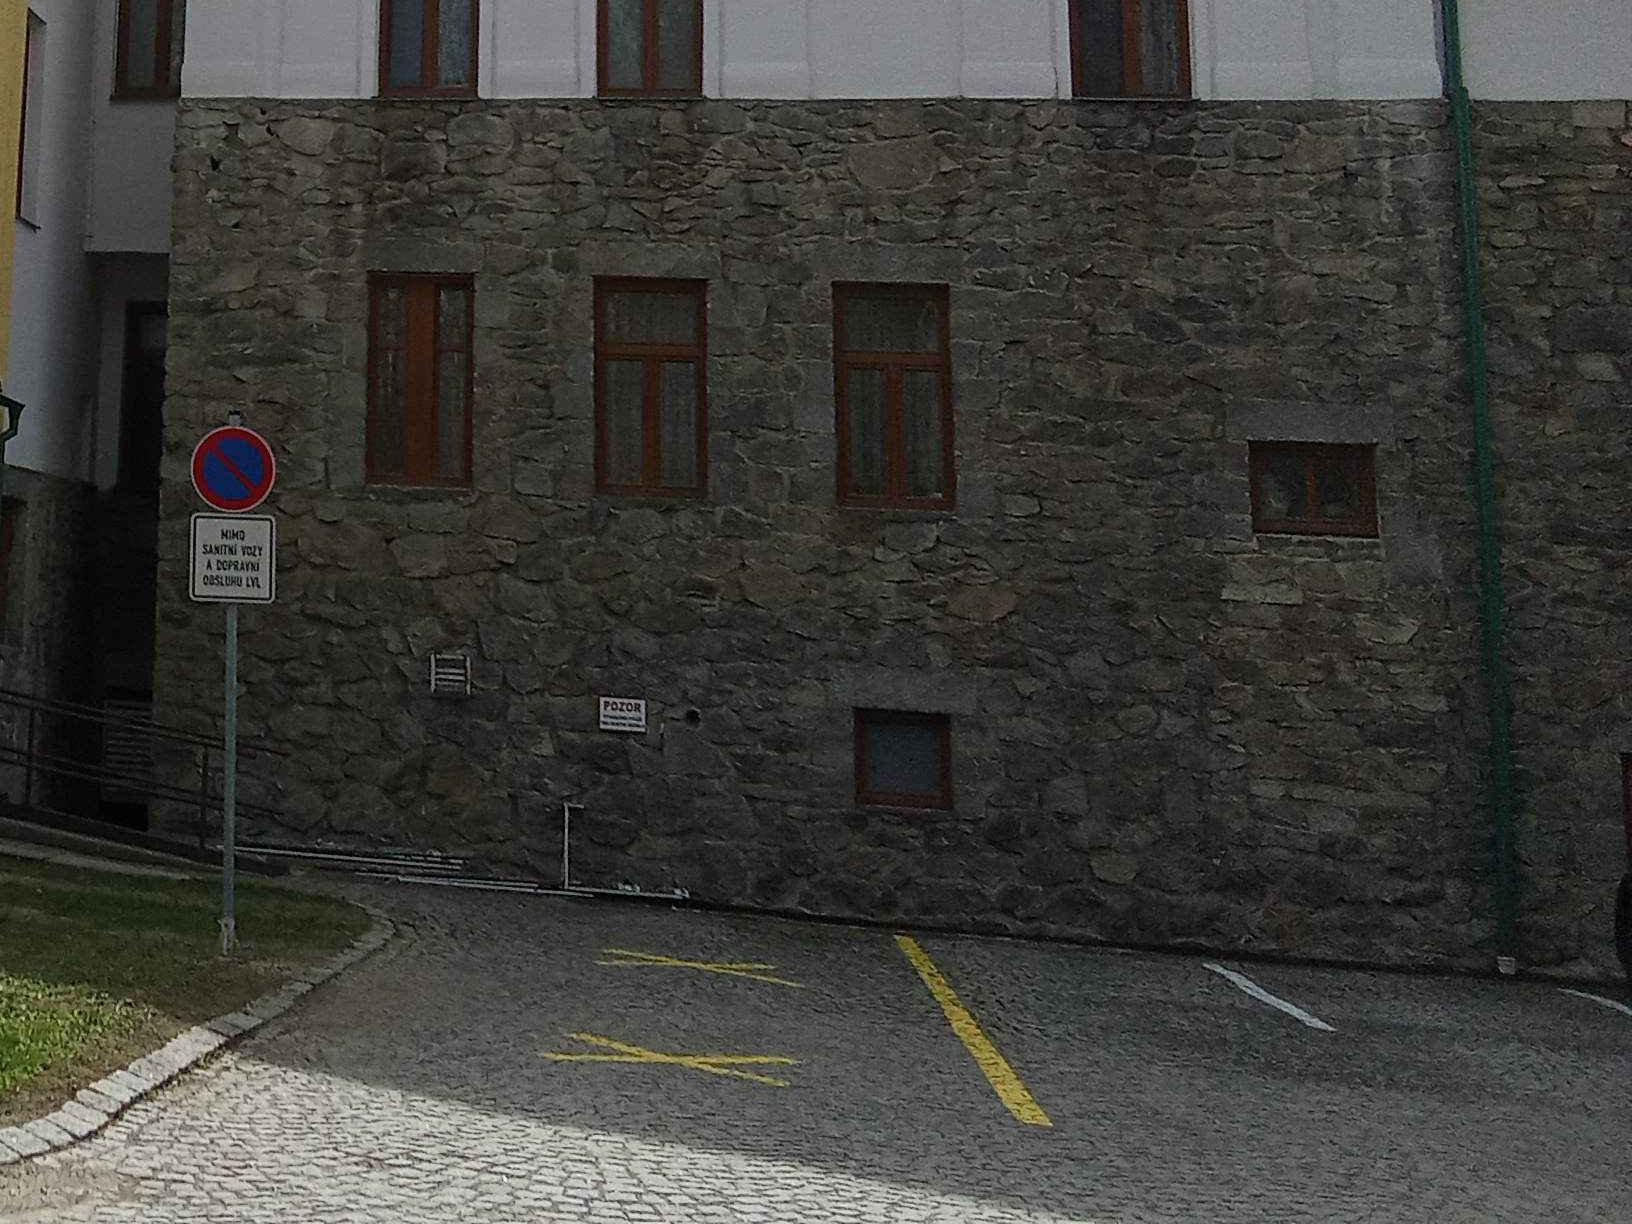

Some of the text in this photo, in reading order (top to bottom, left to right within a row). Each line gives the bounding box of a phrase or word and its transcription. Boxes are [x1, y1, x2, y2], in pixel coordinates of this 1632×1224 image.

[221, 528, 245, 541] MIMO
[202, 543, 263, 557] SANITNÍ VOZY
[206, 558, 260, 572] A DOPRAVNÍ
[202, 574, 242, 587] OBSLUHU
[603, 700, 641, 713] POZOR
